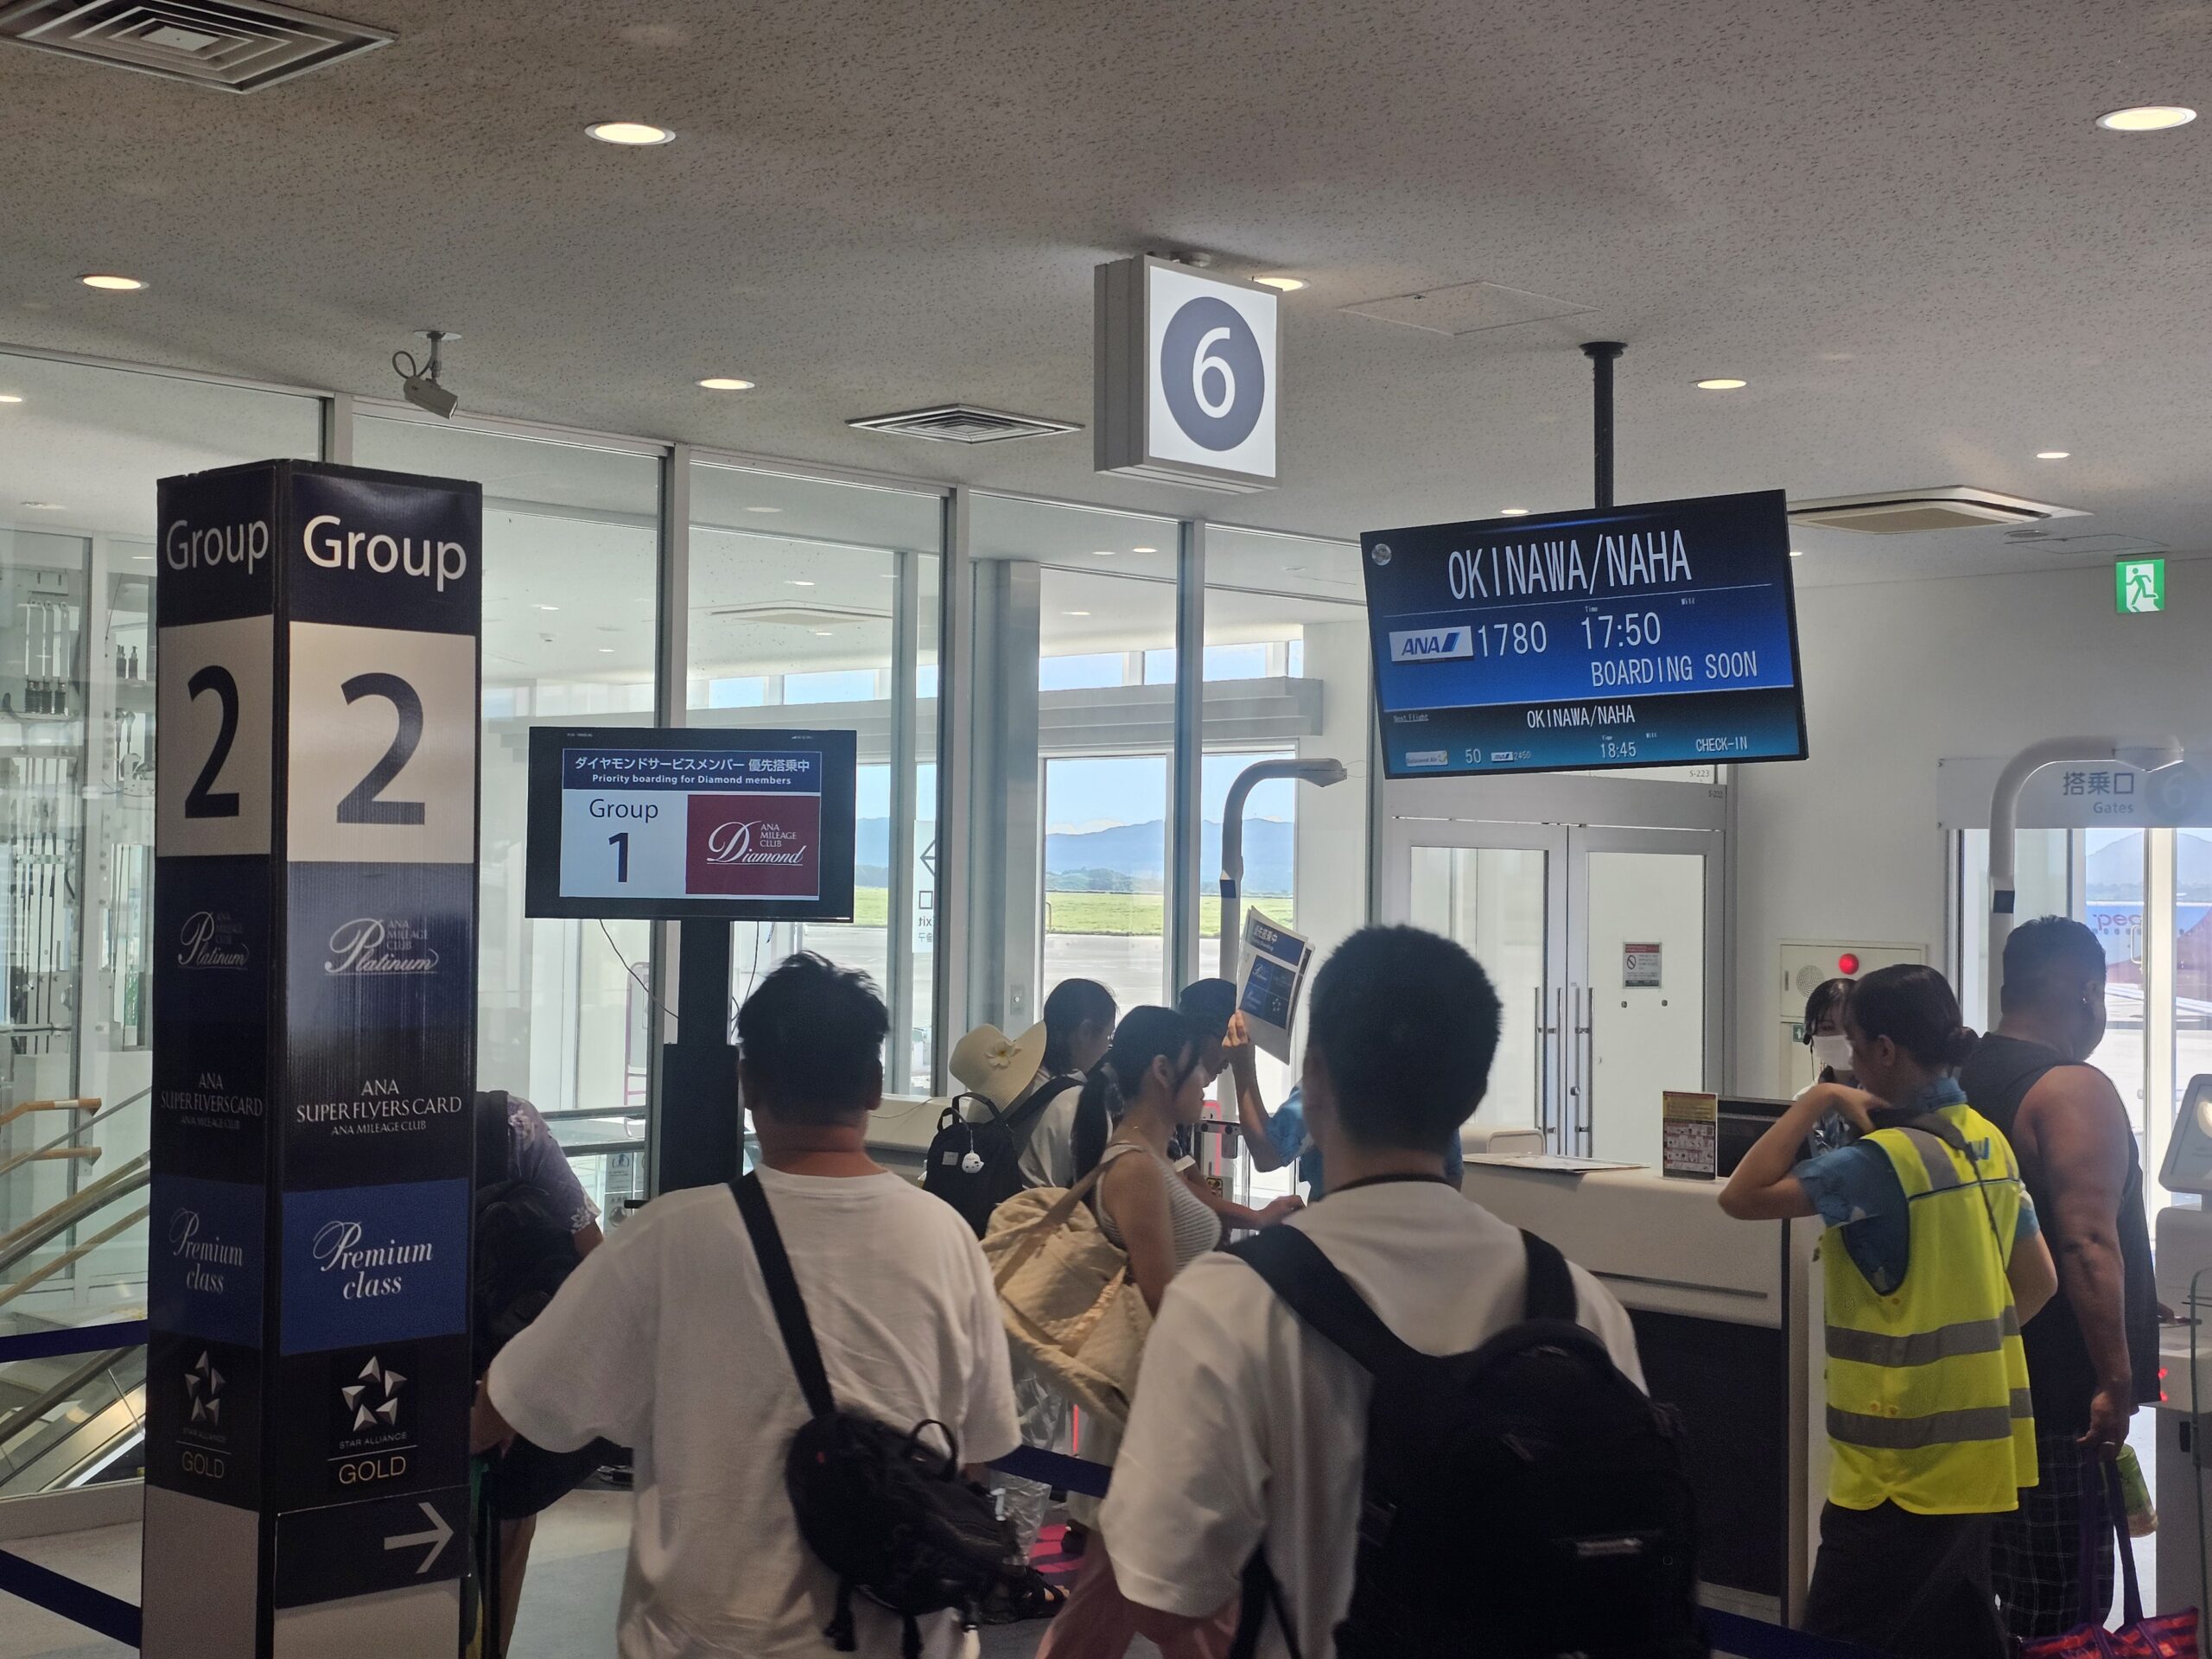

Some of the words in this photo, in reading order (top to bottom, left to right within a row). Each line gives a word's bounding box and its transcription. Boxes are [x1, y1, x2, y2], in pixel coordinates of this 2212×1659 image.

[1192, 326, 1236, 419] 6
[166, 518, 269, 575] Group
[302, 514, 467, 593] Group
[1447, 529, 1693, 601] OKINAWA/NAHA
[1401, 636, 1440, 657] ANA
[1477, 620, 1548, 658] 1780
[1580, 611, 1661, 650] 17:50
[1591, 655, 1694, 688] BOARDING
[1705, 651, 1758, 680] SOON
[1526, 704, 1636, 729] OKINAWA/NAHA
[184, 664, 240, 819] 2
[336, 671, 425, 826] 2
[1600, 741, 1637, 759] 18:45
[1695, 736, 1748, 752] CHECK-IN
[575, 756, 745, 771] ダイヤモンドサービスメンバー
[748, 760, 810, 772] 優先搭乗中
[1465, 748, 1482, 764] 50
[592, 774, 630, 785] Priority
[632, 774, 677, 785] boarding
[680, 775, 695, 784] for
[698, 775, 742, 785] Diamond
[745, 776, 791, 785] members
[2063, 771, 2134, 796] 搭乗口
[589, 798, 658, 823] Group
[2093, 801, 2134, 814] Gates
[706, 820, 808, 864] Diamond
[760, 831, 798, 840] MILEAGE
[607, 832, 629, 883] 1
[386, 919, 410, 929] ANA
[177, 911, 250, 967] Platinum
[324, 918, 439, 973] Platinum
[386, 940, 412, 950] CLUB
[199, 1071, 224, 1090] ANA
[361, 1078, 399, 1096] ANA
[160, 1090, 193, 1110] SUPER
[231, 1096, 264, 1117] CARD
[296, 1101, 350, 1123] SUPER
[353, 1098, 410, 1120] FLYERS
[411, 1096, 462, 1116] CARD
[331, 1124, 354, 1135] ANA
[356, 1122, 400, 1135] MILEAGE
[401, 1120, 427, 1131] CLUB
[168, 1208, 244, 1267] Premium
[312, 1220, 433, 1272] Premium
[186, 1264, 225, 1294] class
[342, 1271, 403, 1300] class
[339, 1439, 362, 1450] STAR
[364, 1432, 408, 1446] ALLIANCE
[181, 1451, 226, 1479] GOLD
[338, 1455, 407, 1484] GOLD
